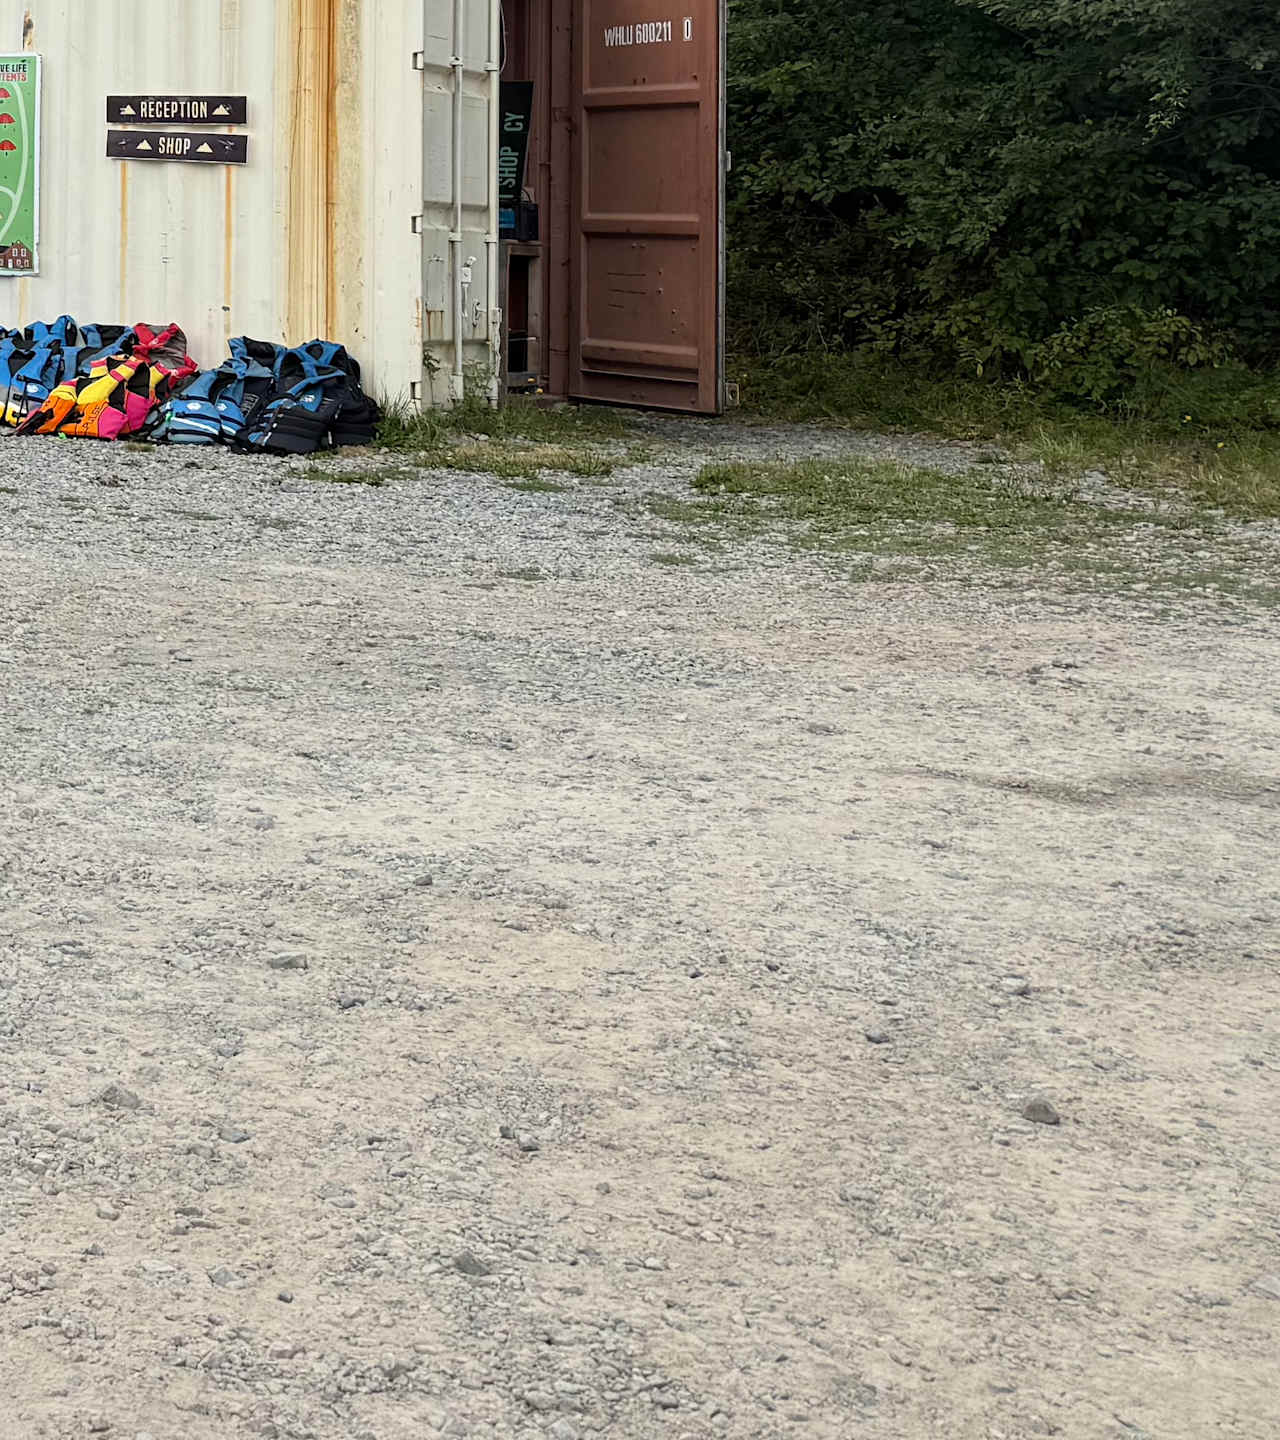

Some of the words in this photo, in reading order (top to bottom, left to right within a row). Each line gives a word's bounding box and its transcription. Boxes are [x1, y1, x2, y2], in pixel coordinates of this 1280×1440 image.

[604, 24, 633, 47] WHLU
[635, 20, 672, 44] 600211
[11, 63, 27, 73] LIFE
[140, 101, 208, 118] RECEPTION
[158, 137, 191, 155] SHOP
